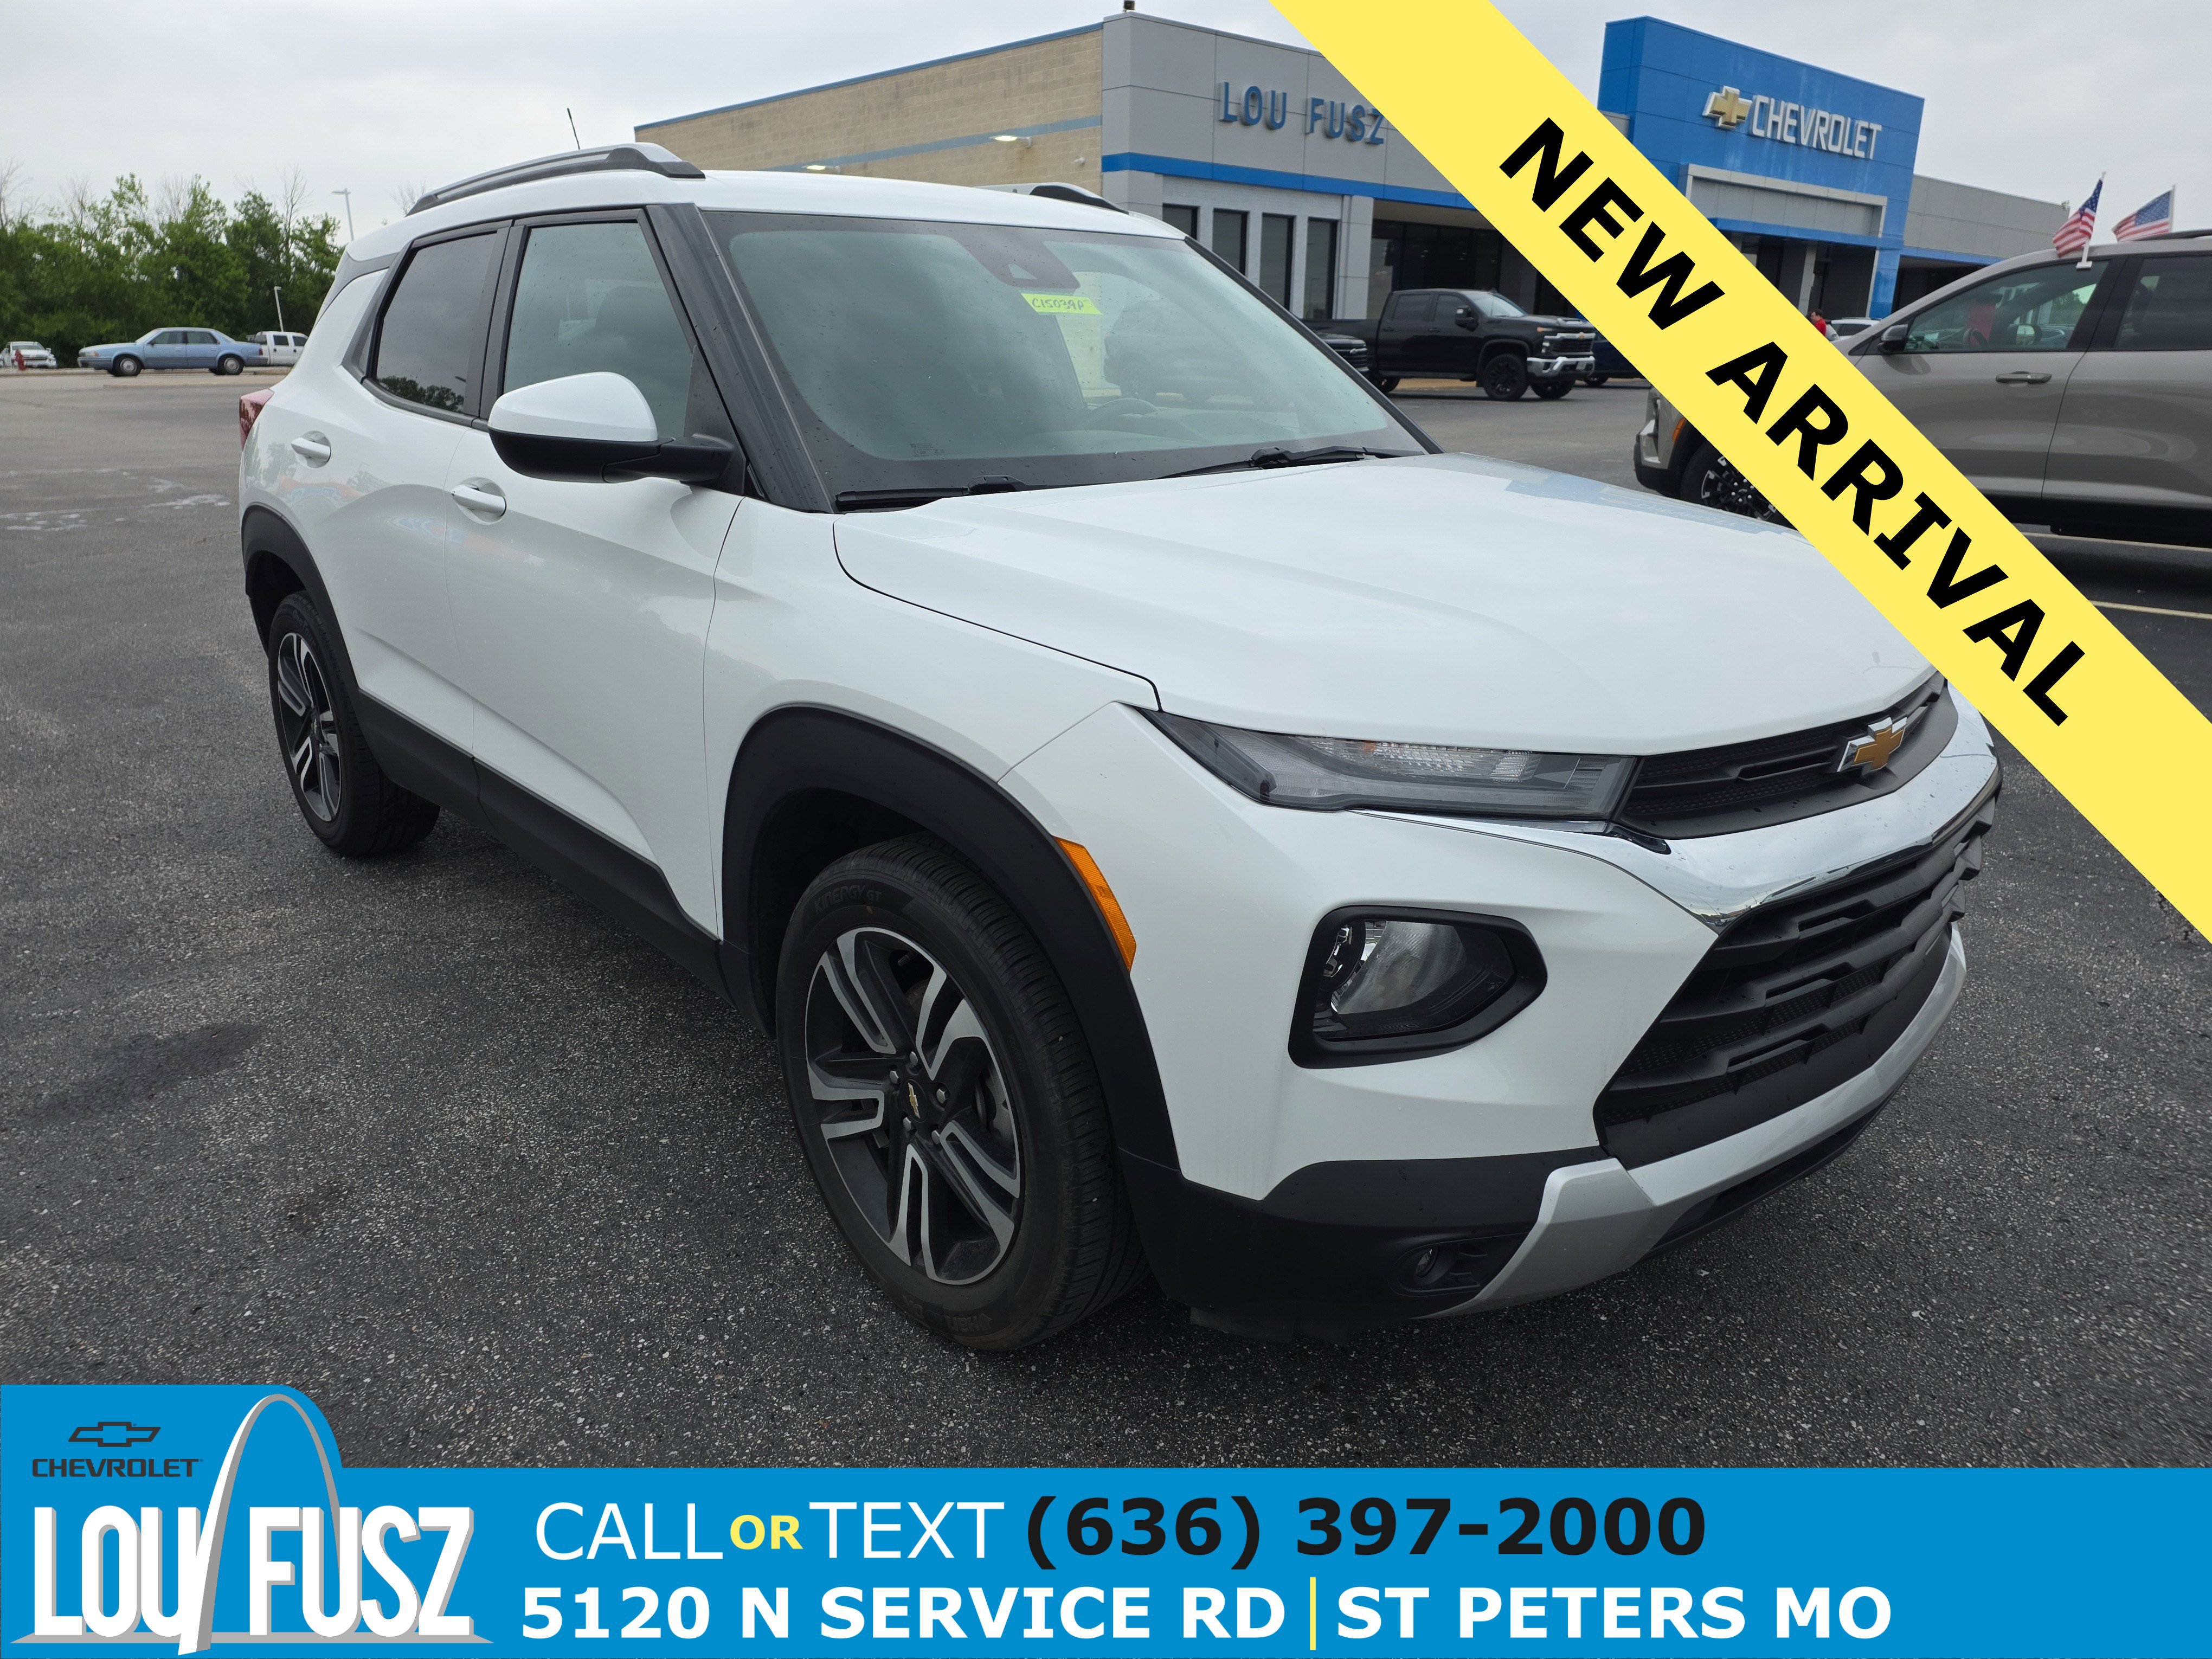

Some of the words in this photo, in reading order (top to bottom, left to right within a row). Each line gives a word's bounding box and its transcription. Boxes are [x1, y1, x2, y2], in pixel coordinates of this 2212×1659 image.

[1218, 81, 1287, 130] LOU
[1305, 97, 1385, 145] FUSZ
[1751, 94, 1882, 160] CHEVROLET
[866, 889, 883, 903] GT
